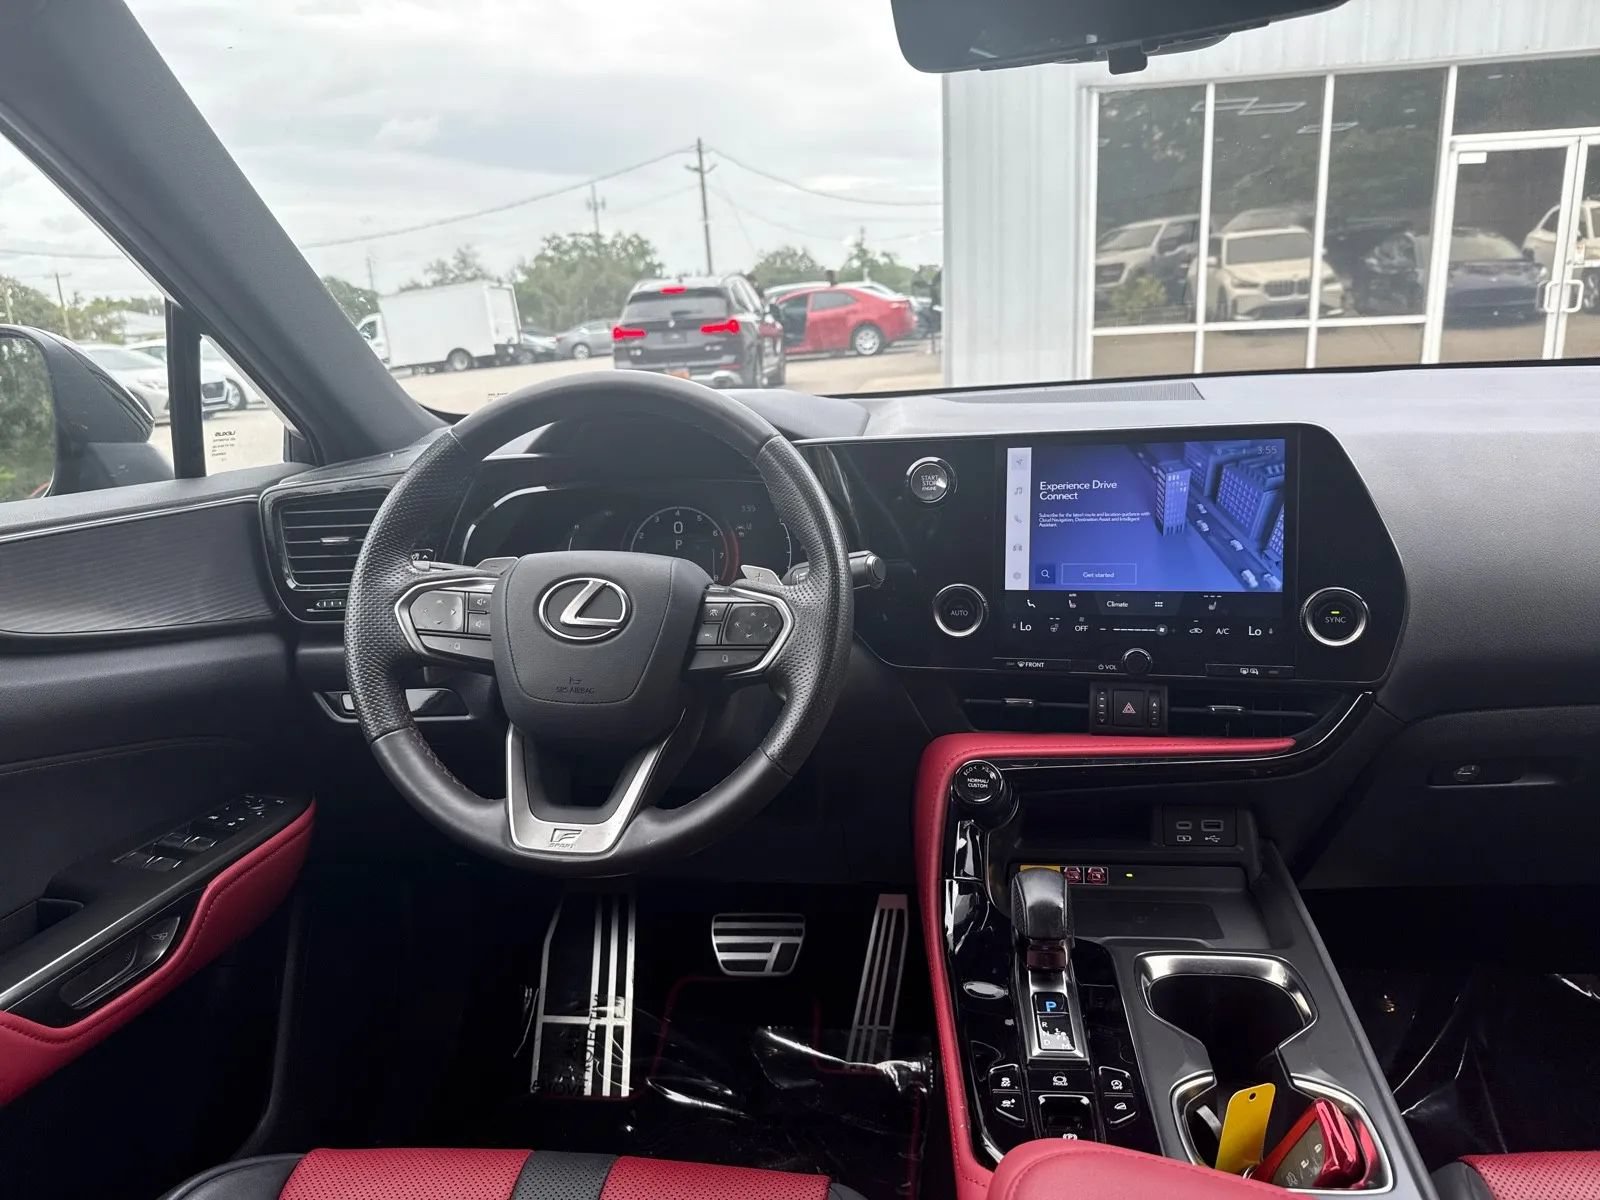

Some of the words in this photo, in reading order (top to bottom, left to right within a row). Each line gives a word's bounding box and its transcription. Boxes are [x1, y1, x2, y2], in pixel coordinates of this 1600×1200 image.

[1257, 445, 1278, 455] 3:55
[1039, 481, 1090, 492] Experience
[1092, 479, 1118, 489] Drive
[1039, 491, 1079, 501] Connect
[675, 540, 683, 550] P
[1106, 600, 1128, 608] Climate
[1020, 620, 1032, 631] Lo
[1248, 626, 1262, 636] Lo
[1046, 1001, 1057, 1012] P
